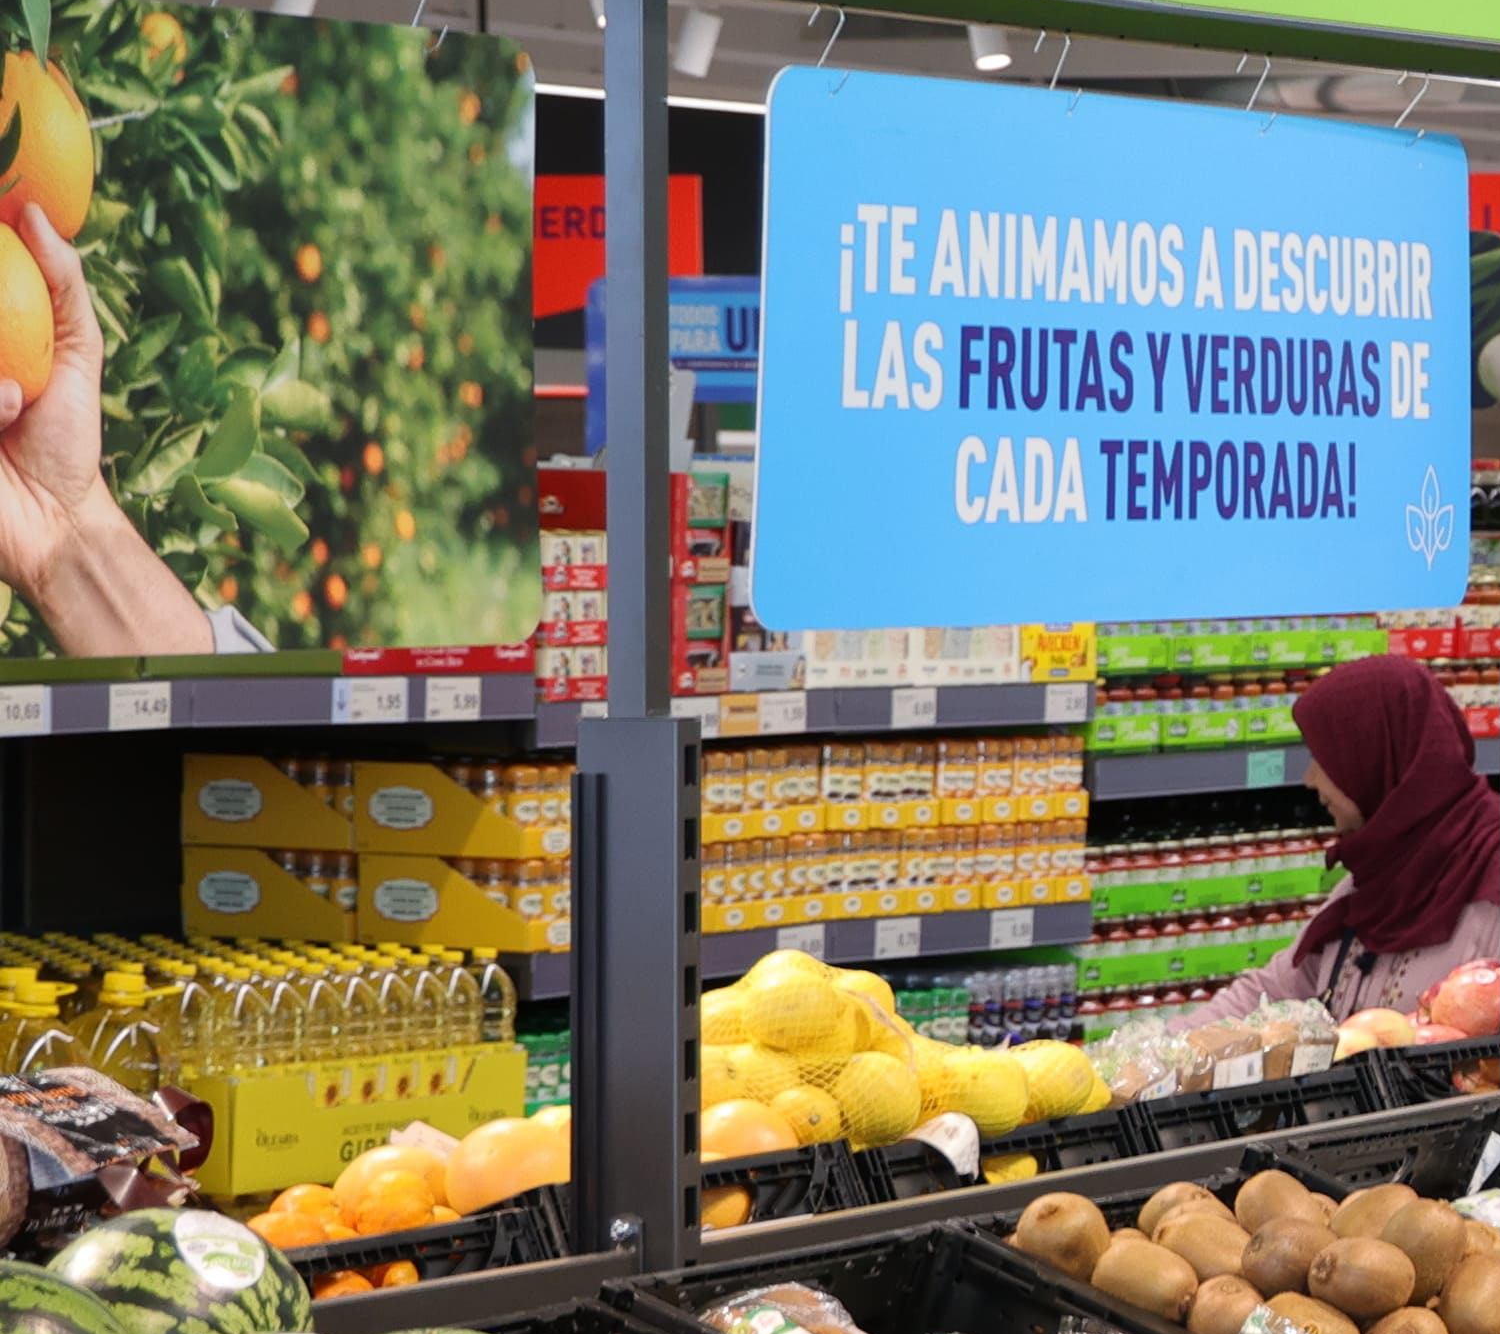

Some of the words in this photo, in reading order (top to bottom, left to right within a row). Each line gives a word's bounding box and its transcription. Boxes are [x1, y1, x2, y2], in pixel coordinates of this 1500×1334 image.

[838, 203, 917, 313] ¡TE
[929, 208, 1185, 310] ANIMAMOS
[1194, 228, 1226, 310] A
[1234, 229, 1433, 320] DESCUBRIR
[725, 307, 759, 352] U
[842, 320, 944, 411] LAS
[958, 324, 1135, 413] FRUTAS
[1145, 332, 1171, 414] Y
[1181, 333, 1382, 419] VERDURAS
[1390, 342, 1431, 419] DE
[954, 436, 1088, 524] CADA
[1099, 440, 1359, 522] TEMPORADA!
